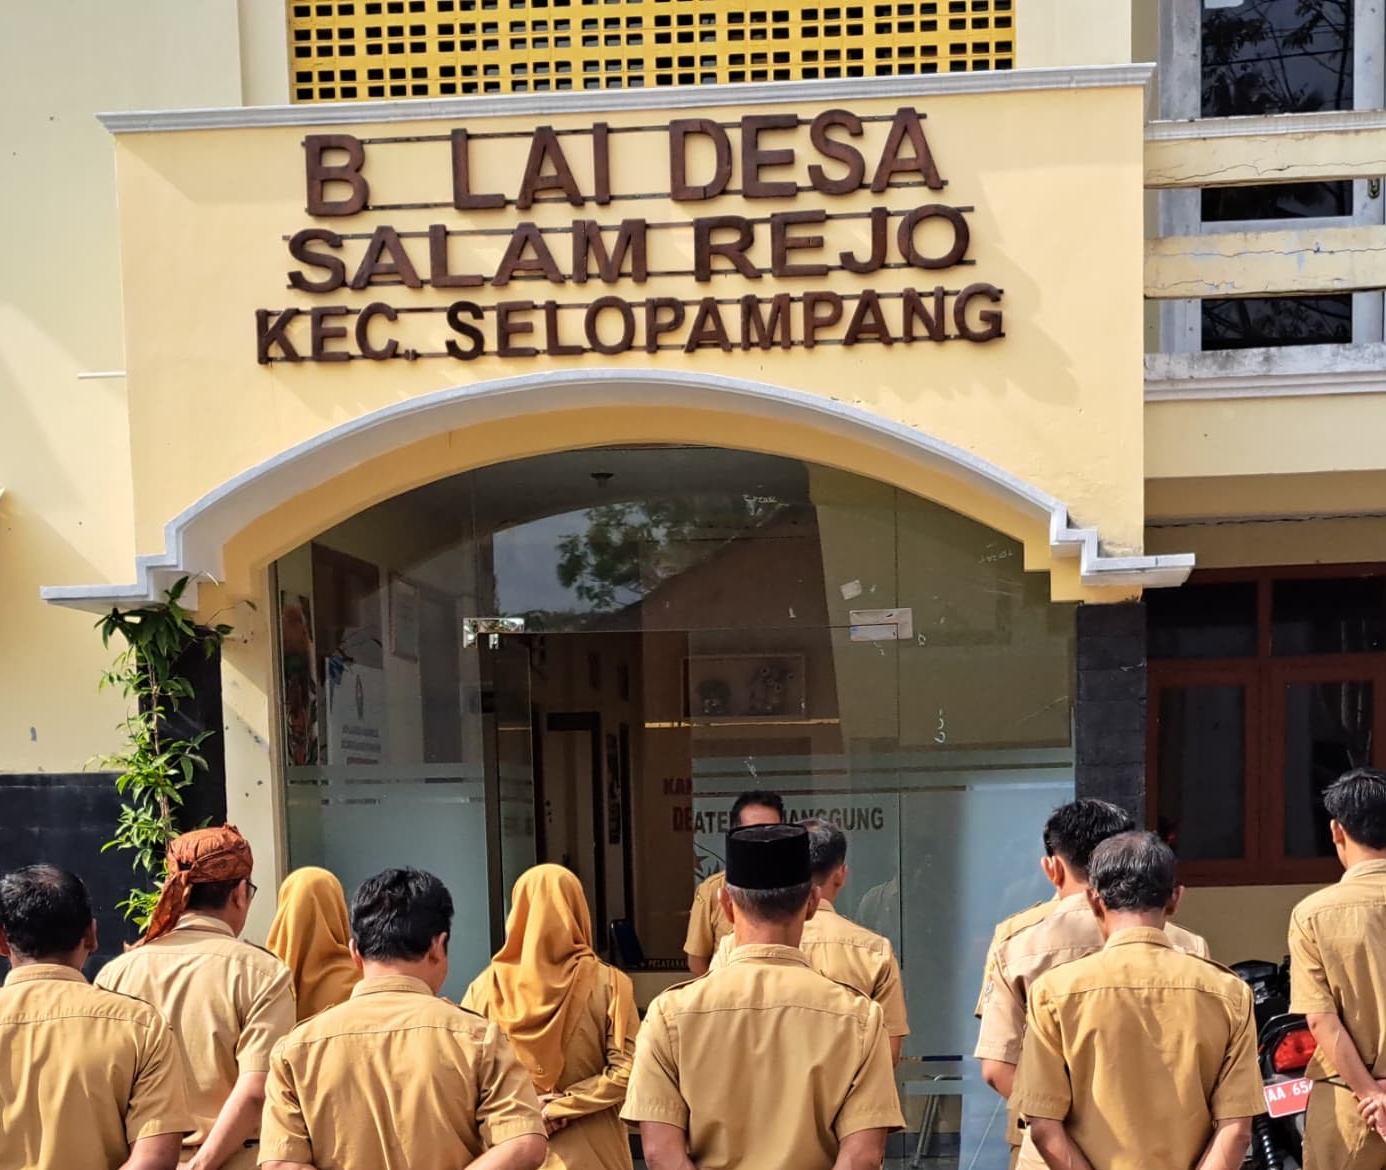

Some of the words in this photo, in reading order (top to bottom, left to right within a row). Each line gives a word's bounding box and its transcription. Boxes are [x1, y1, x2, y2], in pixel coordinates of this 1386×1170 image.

[669, 107, 944, 201] DESA
[256, 302, 417, 364] KEC.
[444, 282, 1005, 362] SELOPAMPANG
[1267, 1086, 1287, 1103] AA
